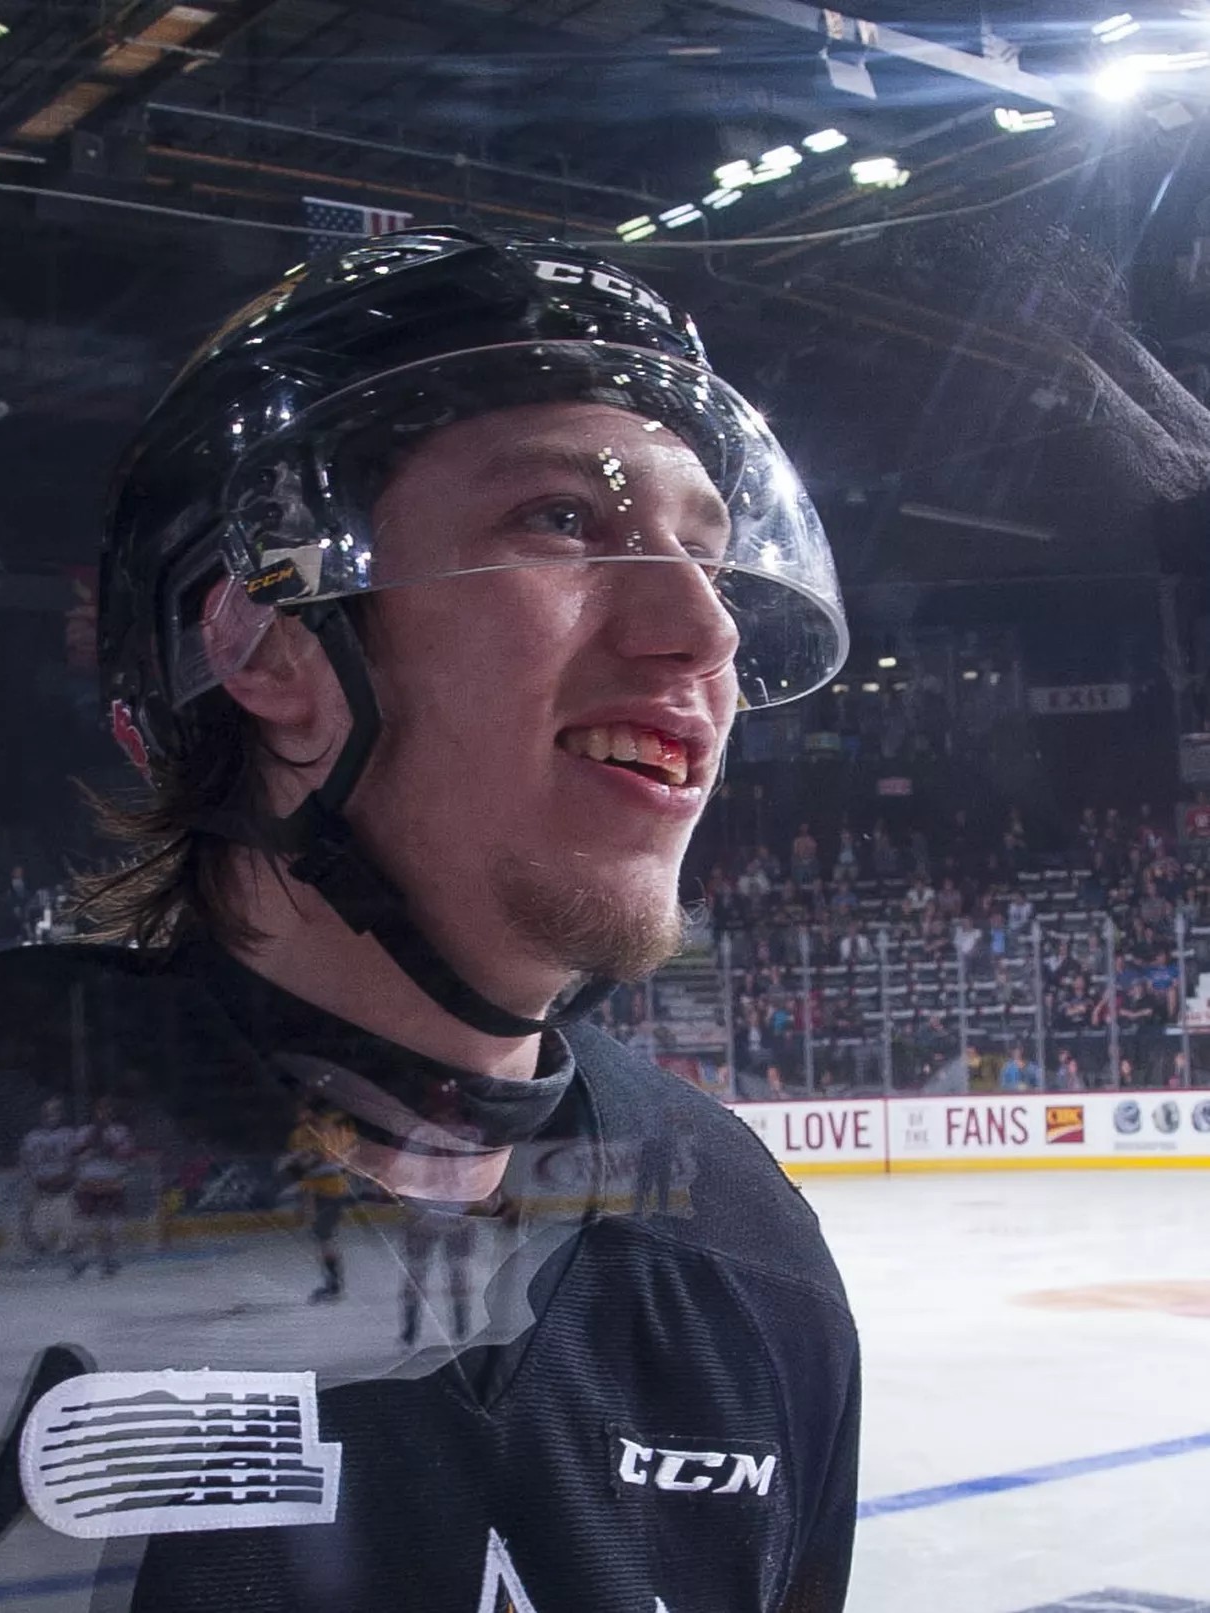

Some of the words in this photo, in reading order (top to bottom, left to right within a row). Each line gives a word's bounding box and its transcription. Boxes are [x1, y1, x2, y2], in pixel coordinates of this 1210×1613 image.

[785, 1110, 872, 1151] LOVE
[946, 1106, 1029, 1146] FANS
[619, 1437, 777, 1496] CCM
